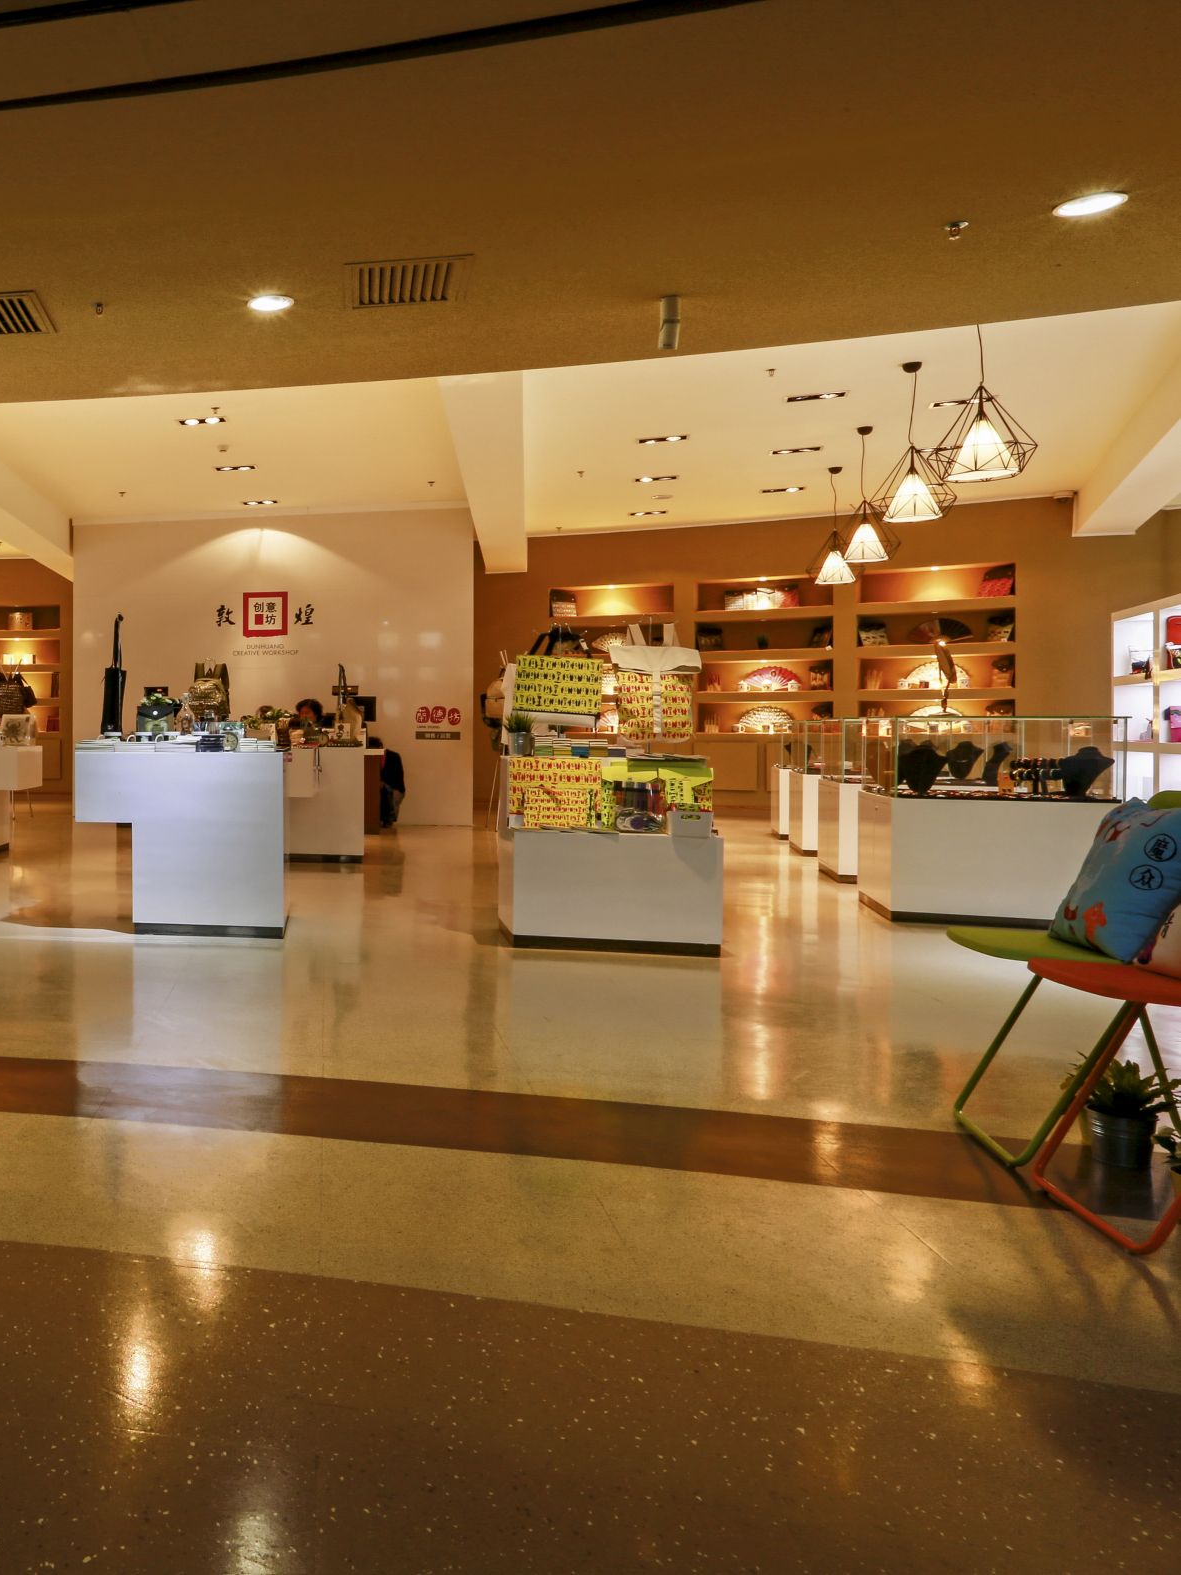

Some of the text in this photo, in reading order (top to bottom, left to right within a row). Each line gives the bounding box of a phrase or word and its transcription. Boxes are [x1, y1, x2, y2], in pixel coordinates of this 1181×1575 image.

[253, 602, 277, 613] 创意
[215, 603, 315, 627] 敦 煌
[265, 614, 277, 625] 坊
